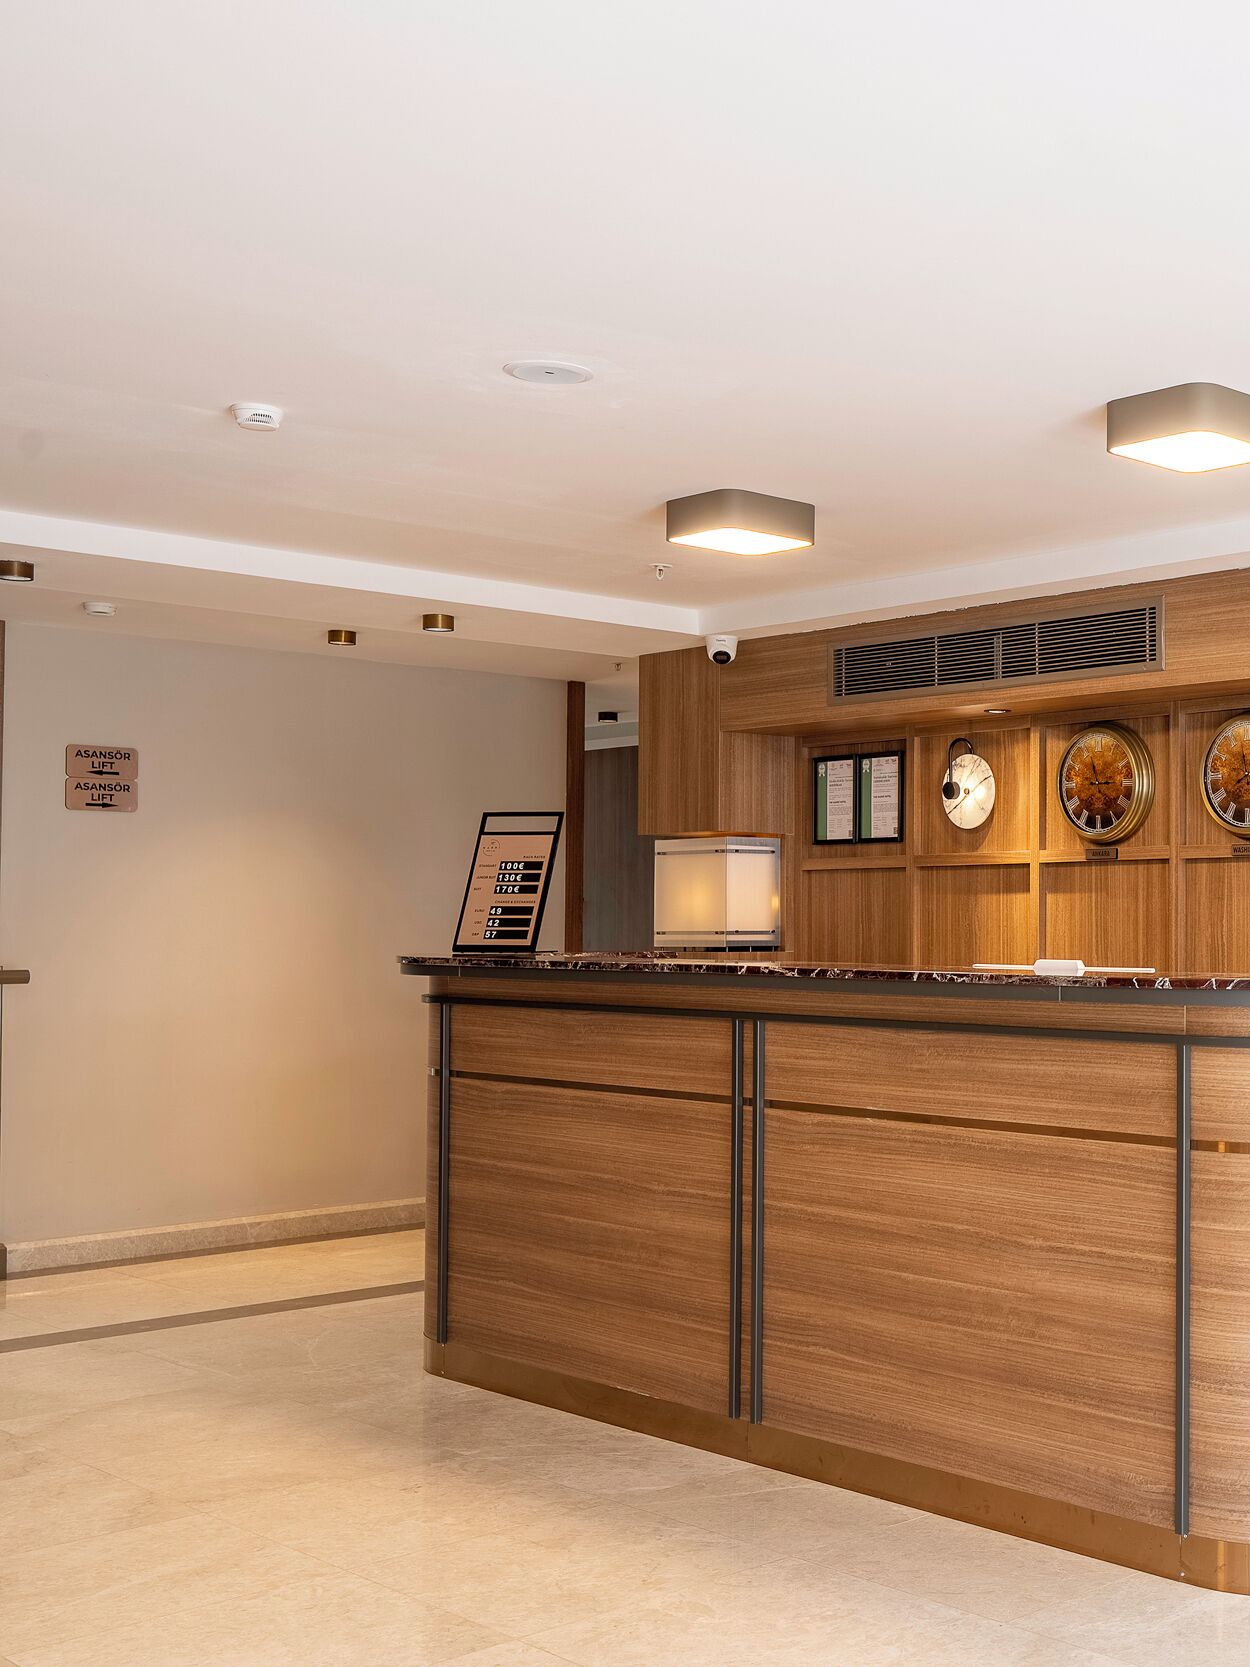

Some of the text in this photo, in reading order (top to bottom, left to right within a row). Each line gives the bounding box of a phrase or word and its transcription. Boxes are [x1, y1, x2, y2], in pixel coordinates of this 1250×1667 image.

[75, 749, 131, 761] ASANSÖR
[92, 761, 115, 770] LIFT
[75, 782, 130, 792] ASANSÖR
[91, 793, 115, 802] LIFT
[501, 862, 524, 870] 100€
[499, 874, 523, 882] 130€
[496, 886, 520, 894] 170€
[490, 907, 502, 915] 49
[487, 919, 499, 927] 42
